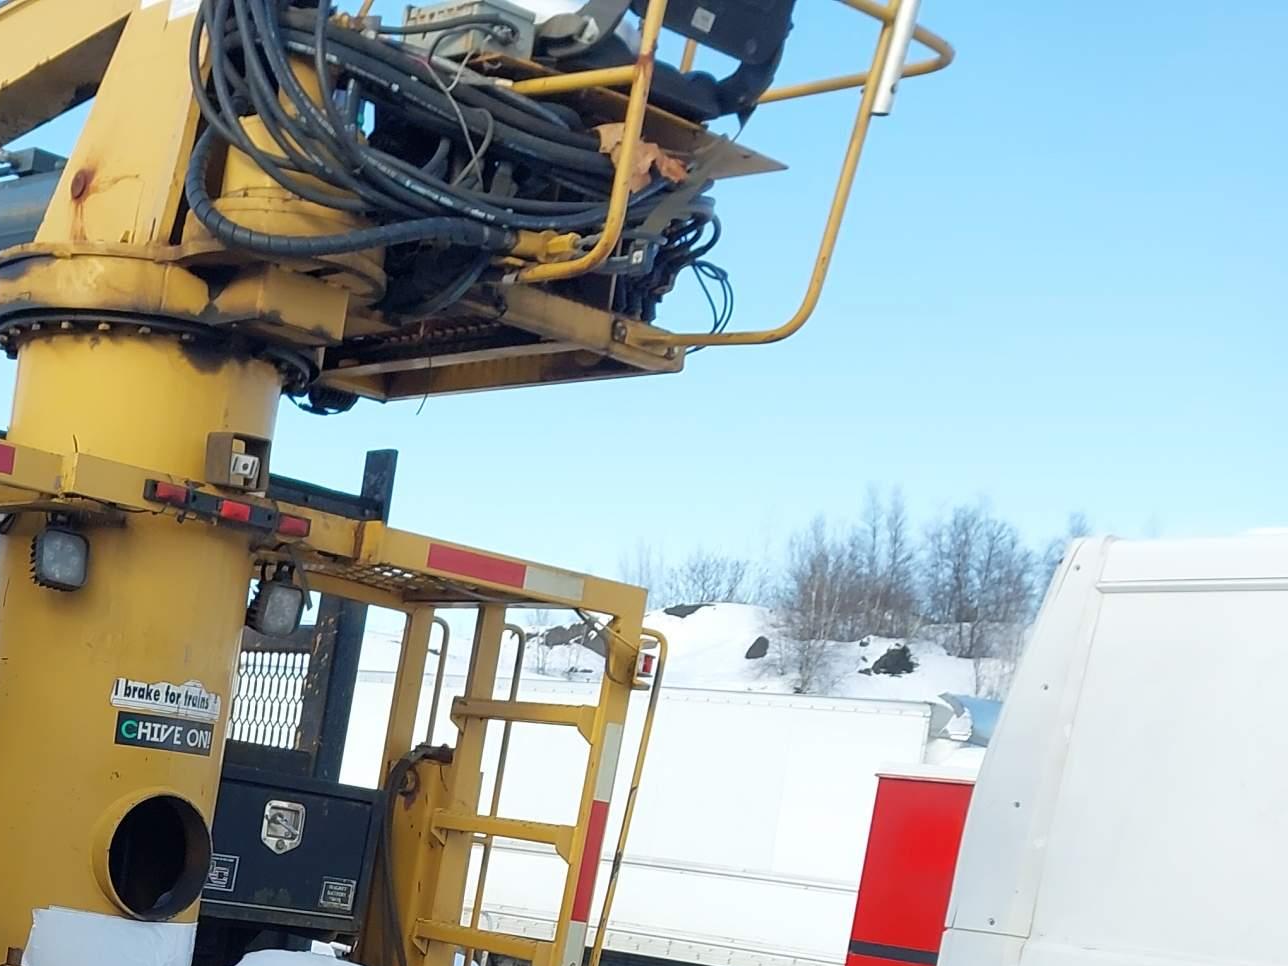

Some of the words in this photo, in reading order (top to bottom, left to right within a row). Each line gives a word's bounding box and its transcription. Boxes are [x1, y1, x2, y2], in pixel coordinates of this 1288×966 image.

[114, 679, 120, 696] I
[124, 678, 161, 702] brake
[164, 684, 182, 705] for
[184, 690, 209, 710] trains
[120, 719, 184, 745] CHIVE
[186, 728, 212, 750] ON!
